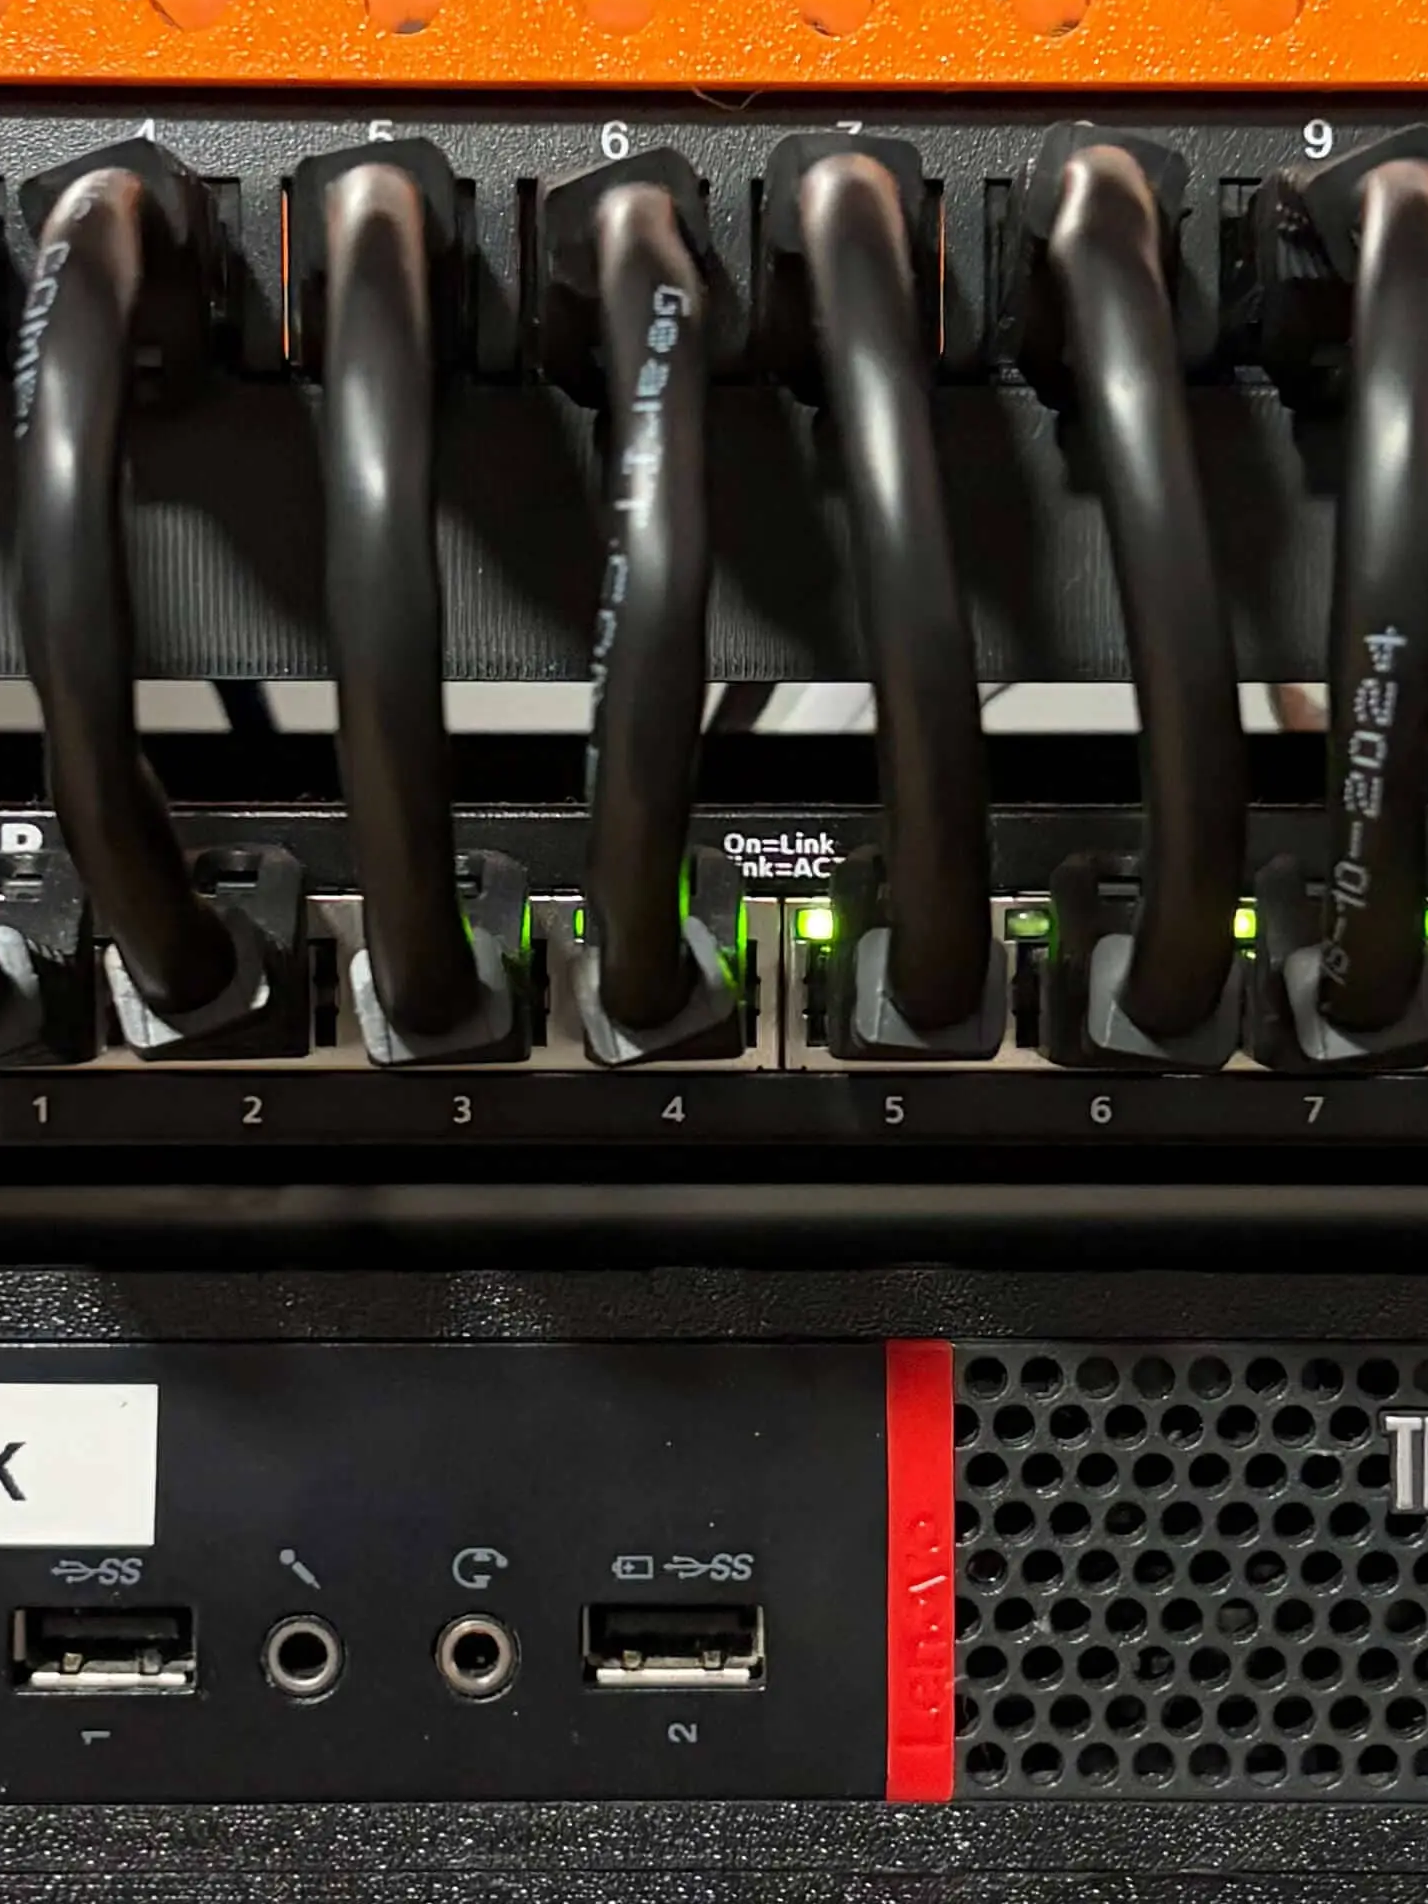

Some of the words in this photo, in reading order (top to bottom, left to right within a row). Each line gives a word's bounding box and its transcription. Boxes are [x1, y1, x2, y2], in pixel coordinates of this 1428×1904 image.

[600, 121, 635, 161] 6
[1303, 119, 1333, 159] 9
[723, 831, 835, 855] On=Link
[32, 1096, 47, 1123] 1
[243, 1095, 262, 1123] 2
[453, 1095, 472, 1124] 3
[661, 1096, 685, 1122] 4
[885, 1096, 904, 1124] 5
[1090, 1096, 1112, 1123] 6
[1303, 1096, 1324, 1123] 7
[667, 1723, 697, 1743] 2
